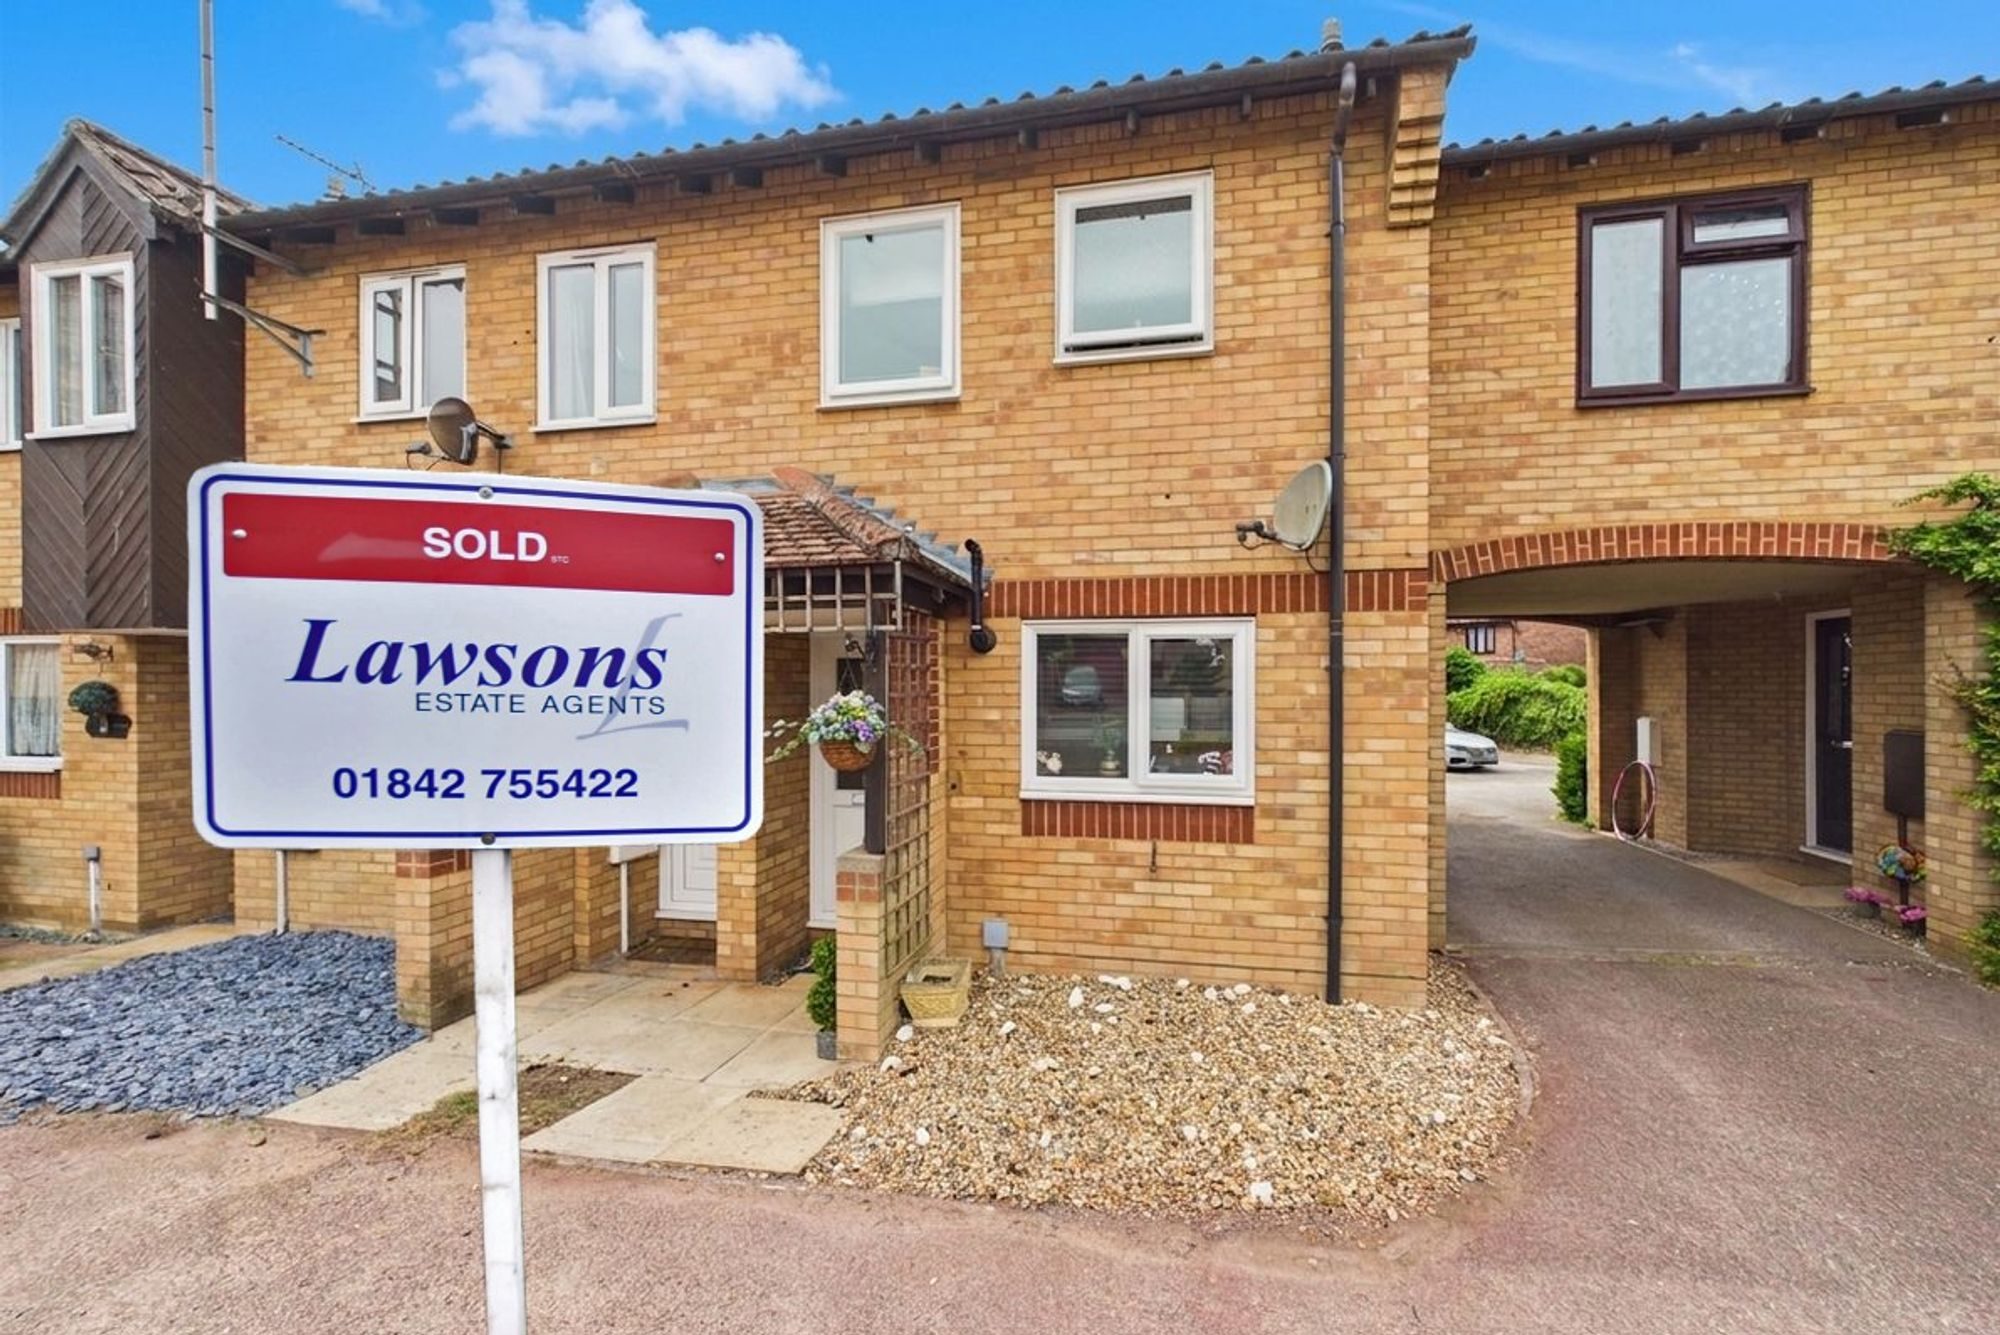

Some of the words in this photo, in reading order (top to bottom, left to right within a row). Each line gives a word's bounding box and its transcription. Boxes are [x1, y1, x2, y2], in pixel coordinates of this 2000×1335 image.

[423, 527, 547, 562] SOLD
[550, 555, 570, 564] STC
[284, 618, 668, 690] Lawsons
[415, 692, 526, 713] ESTATE
[541, 694, 666, 715] AGENTS
[333, 768, 465, 799] 01842
[480, 768, 638, 799] 755422
